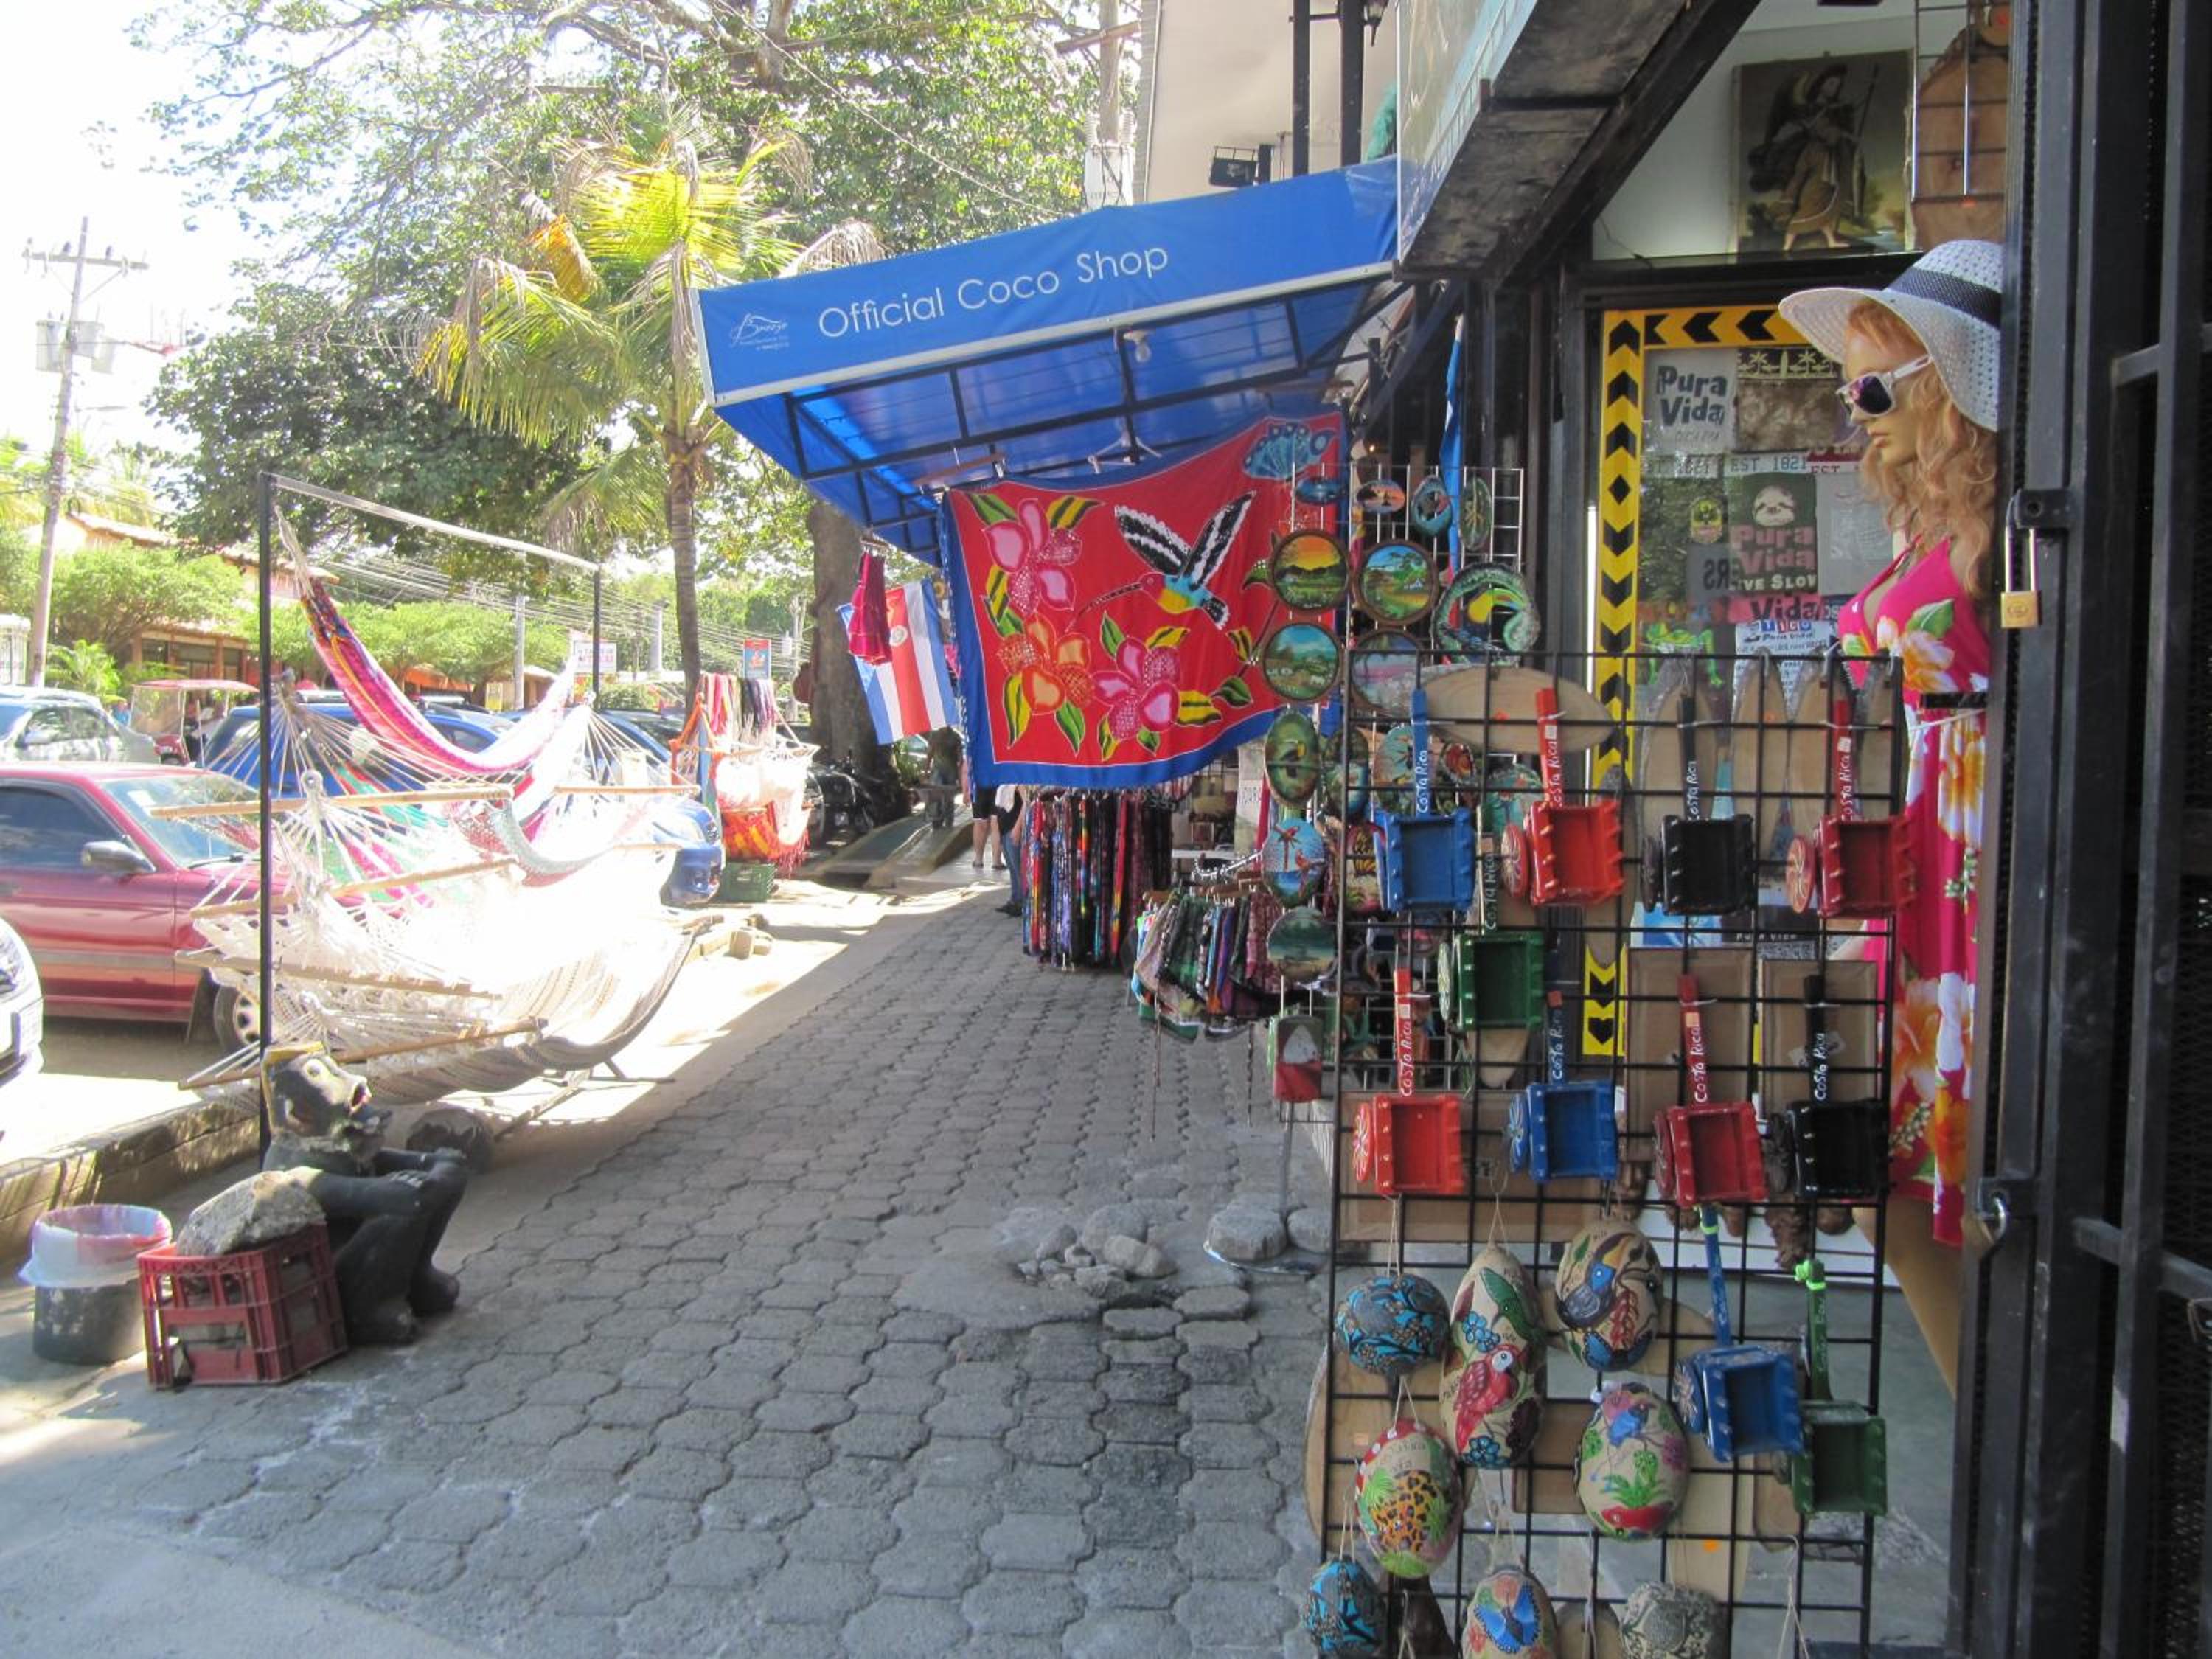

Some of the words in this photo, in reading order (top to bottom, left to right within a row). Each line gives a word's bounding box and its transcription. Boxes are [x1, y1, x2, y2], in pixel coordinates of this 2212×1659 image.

[819, 286, 945, 337] Official
[958, 271, 1060, 309] Coco
[1076, 247, 1169, 283] Shop
[1656, 365, 1728, 397] Pura
[1660, 395, 1725, 426] Vida
[1731, 456, 1760, 473] EST
[1773, 455, 1806, 472] 1821
[1729, 524, 1815, 549] Pura
[1736, 548, 1817, 574] Vida
[1750, 596, 1820, 621] Vida
[1415, 750, 1429, 774] Rica
[1690, 1026, 1704, 1056] Rica
[1813, 1033, 1826, 1060] Rica
